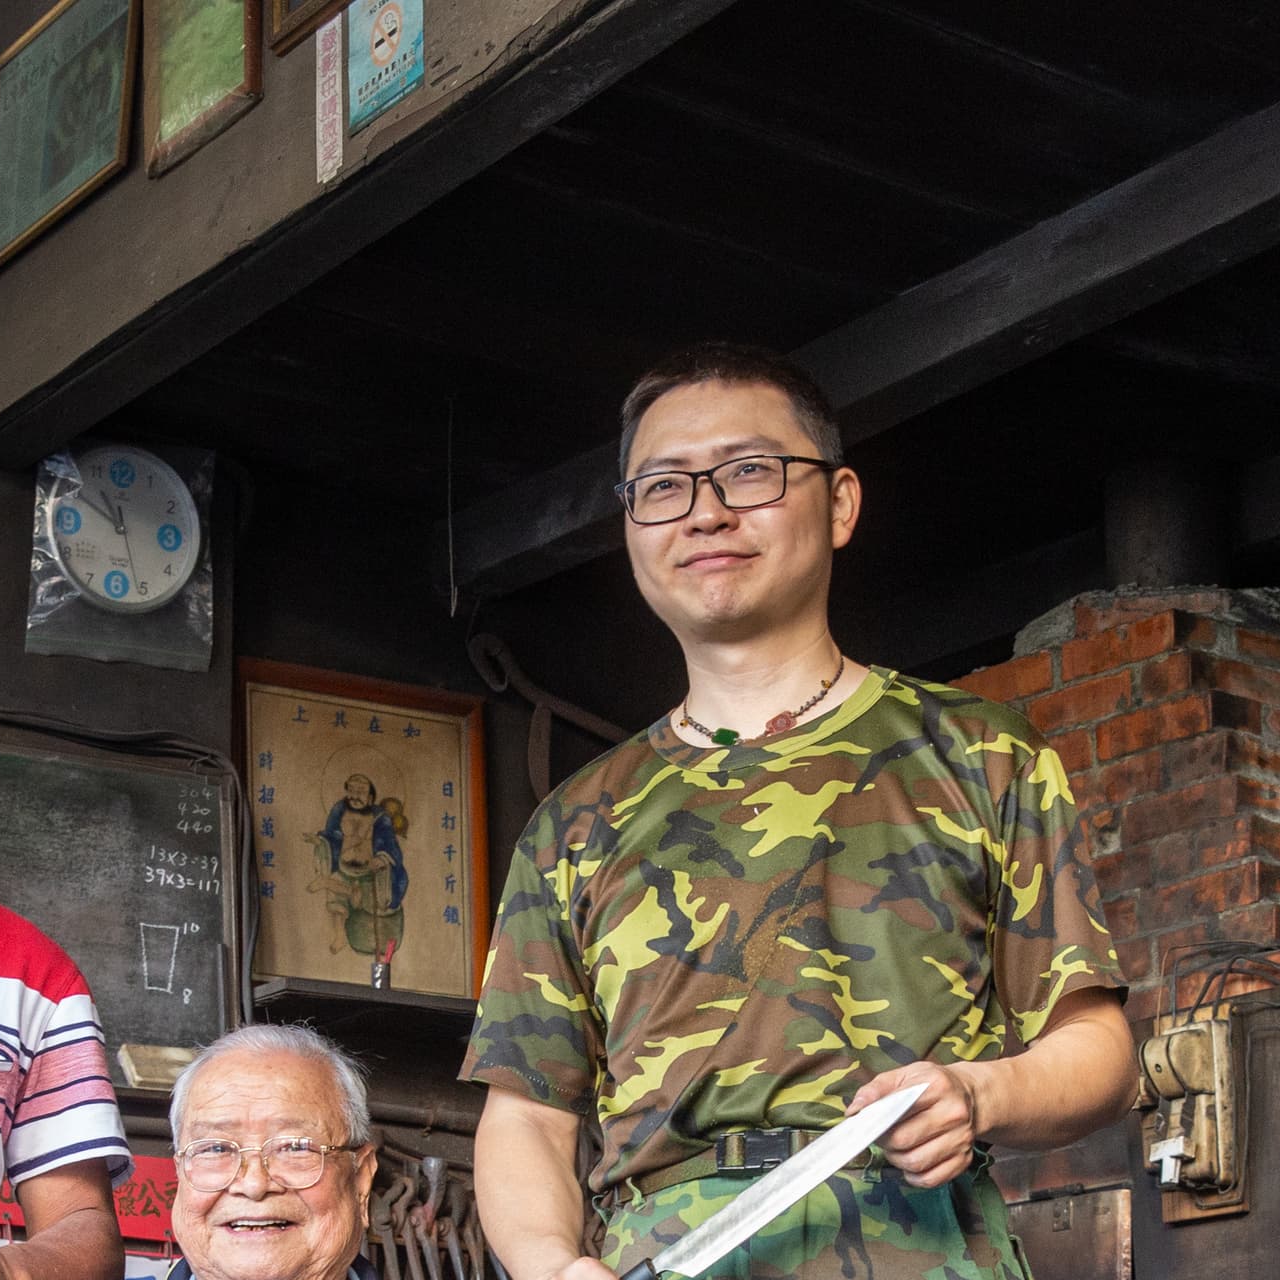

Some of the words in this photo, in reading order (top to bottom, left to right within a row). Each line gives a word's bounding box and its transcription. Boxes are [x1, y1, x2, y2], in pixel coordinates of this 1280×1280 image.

[176, 819, 213, 834] 440
[183, 922, 200, 935] 10
[182, 988, 193, 1005] 8
